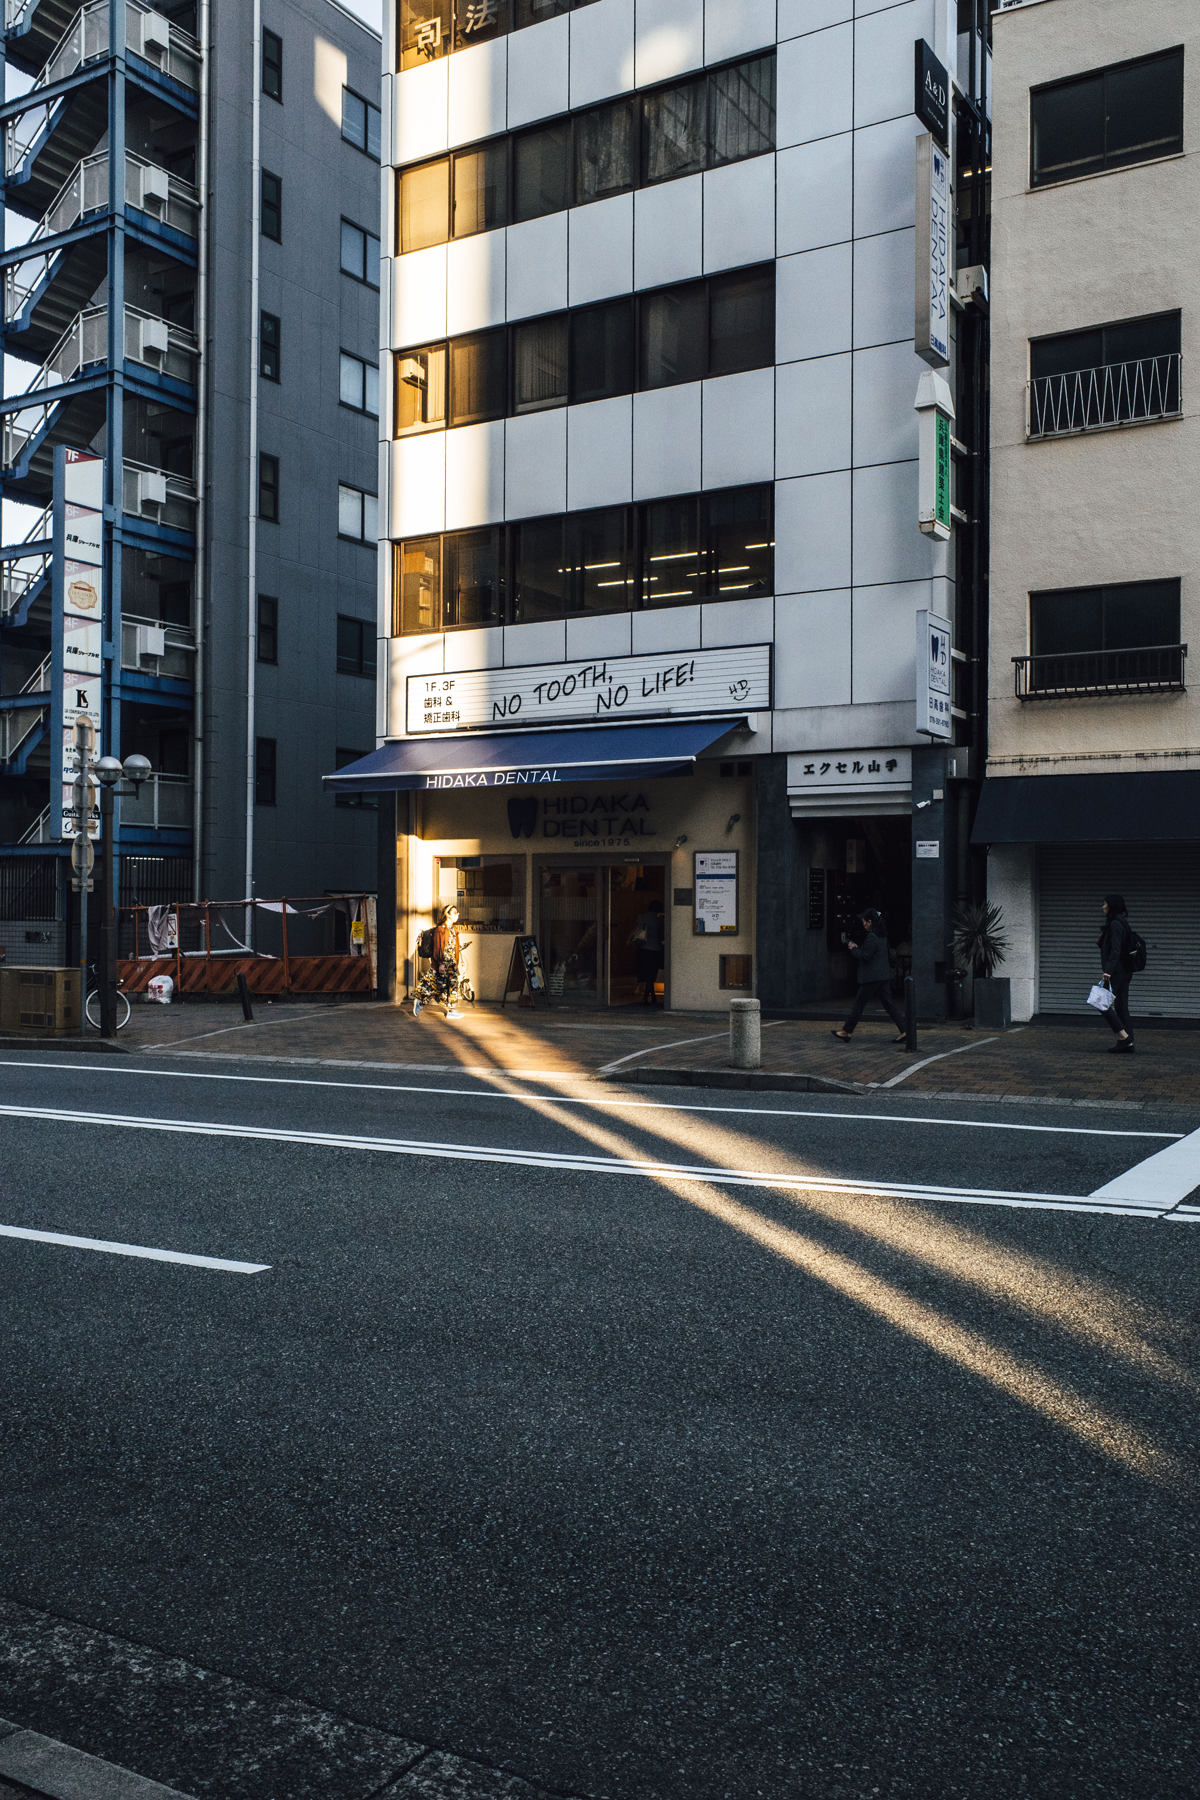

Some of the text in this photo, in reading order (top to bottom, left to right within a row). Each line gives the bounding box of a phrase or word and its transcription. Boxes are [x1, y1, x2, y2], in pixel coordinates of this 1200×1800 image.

[938, 205, 946, 320] HIDAKA
[66, 505, 79, 517] 6F
[65, 562, 79, 573] 5F
[65, 618, 78, 629] 4F
[64, 673, 78, 684] 3F
[597, 660, 694, 713] NO LIFE!
[493, 662, 613, 721] NO TOOTH,
[424, 696, 453, 709] 歯科 &
[424, 711, 460, 724] 矯正歯科
[803, 758, 898, 776] エクセル山手
[426, 770, 562, 789] HIDAKA DENTAL
[543, 794, 650, 815] HIDAKA
[543, 817, 656, 838] DENTAL
